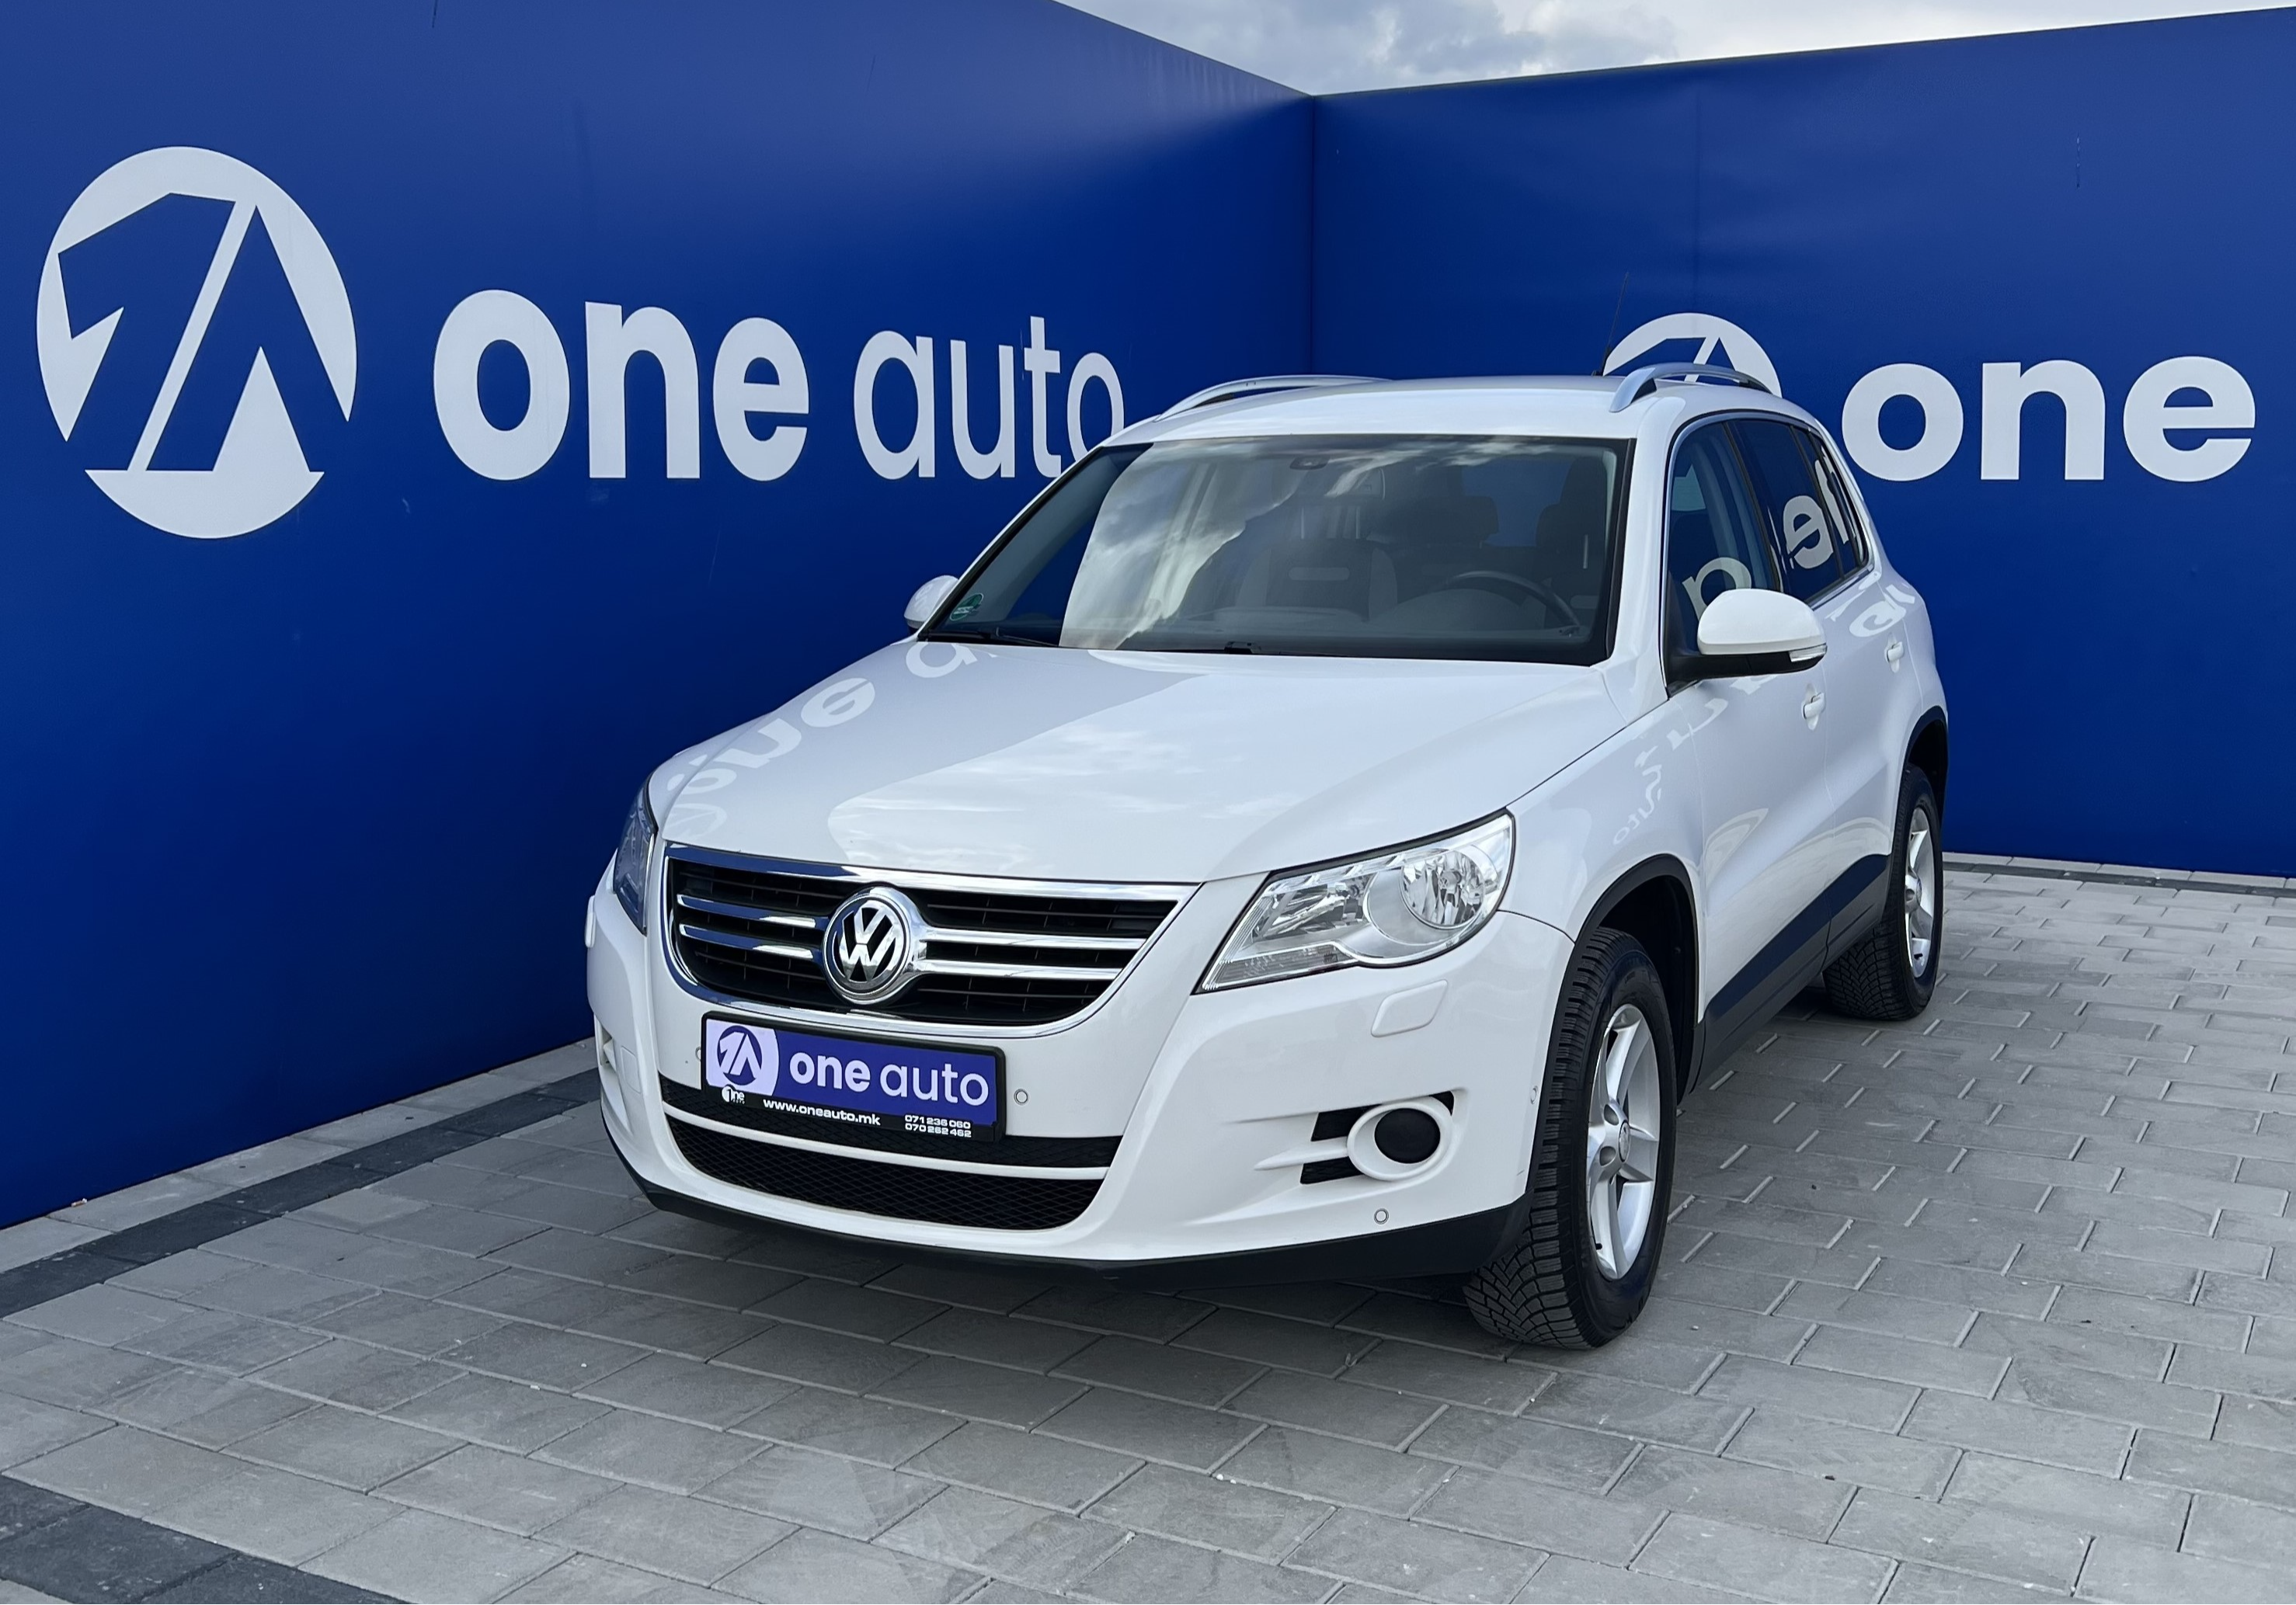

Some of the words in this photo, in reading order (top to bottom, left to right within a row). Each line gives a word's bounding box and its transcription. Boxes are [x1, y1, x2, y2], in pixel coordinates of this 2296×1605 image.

[433, 290, 809, 481] one
[854, 316, 1125, 480] auto
[1842, 356, 2256, 482] one
[789, 1051, 871, 1093] one
[880, 1062, 989, 1106] auto
[763, 1099, 881, 1125] www.oneauto.mk
[904, 1114, 925, 1124] 071
[948, 1120, 971, 1129] 060
[905, 1123, 927, 1132] 070
